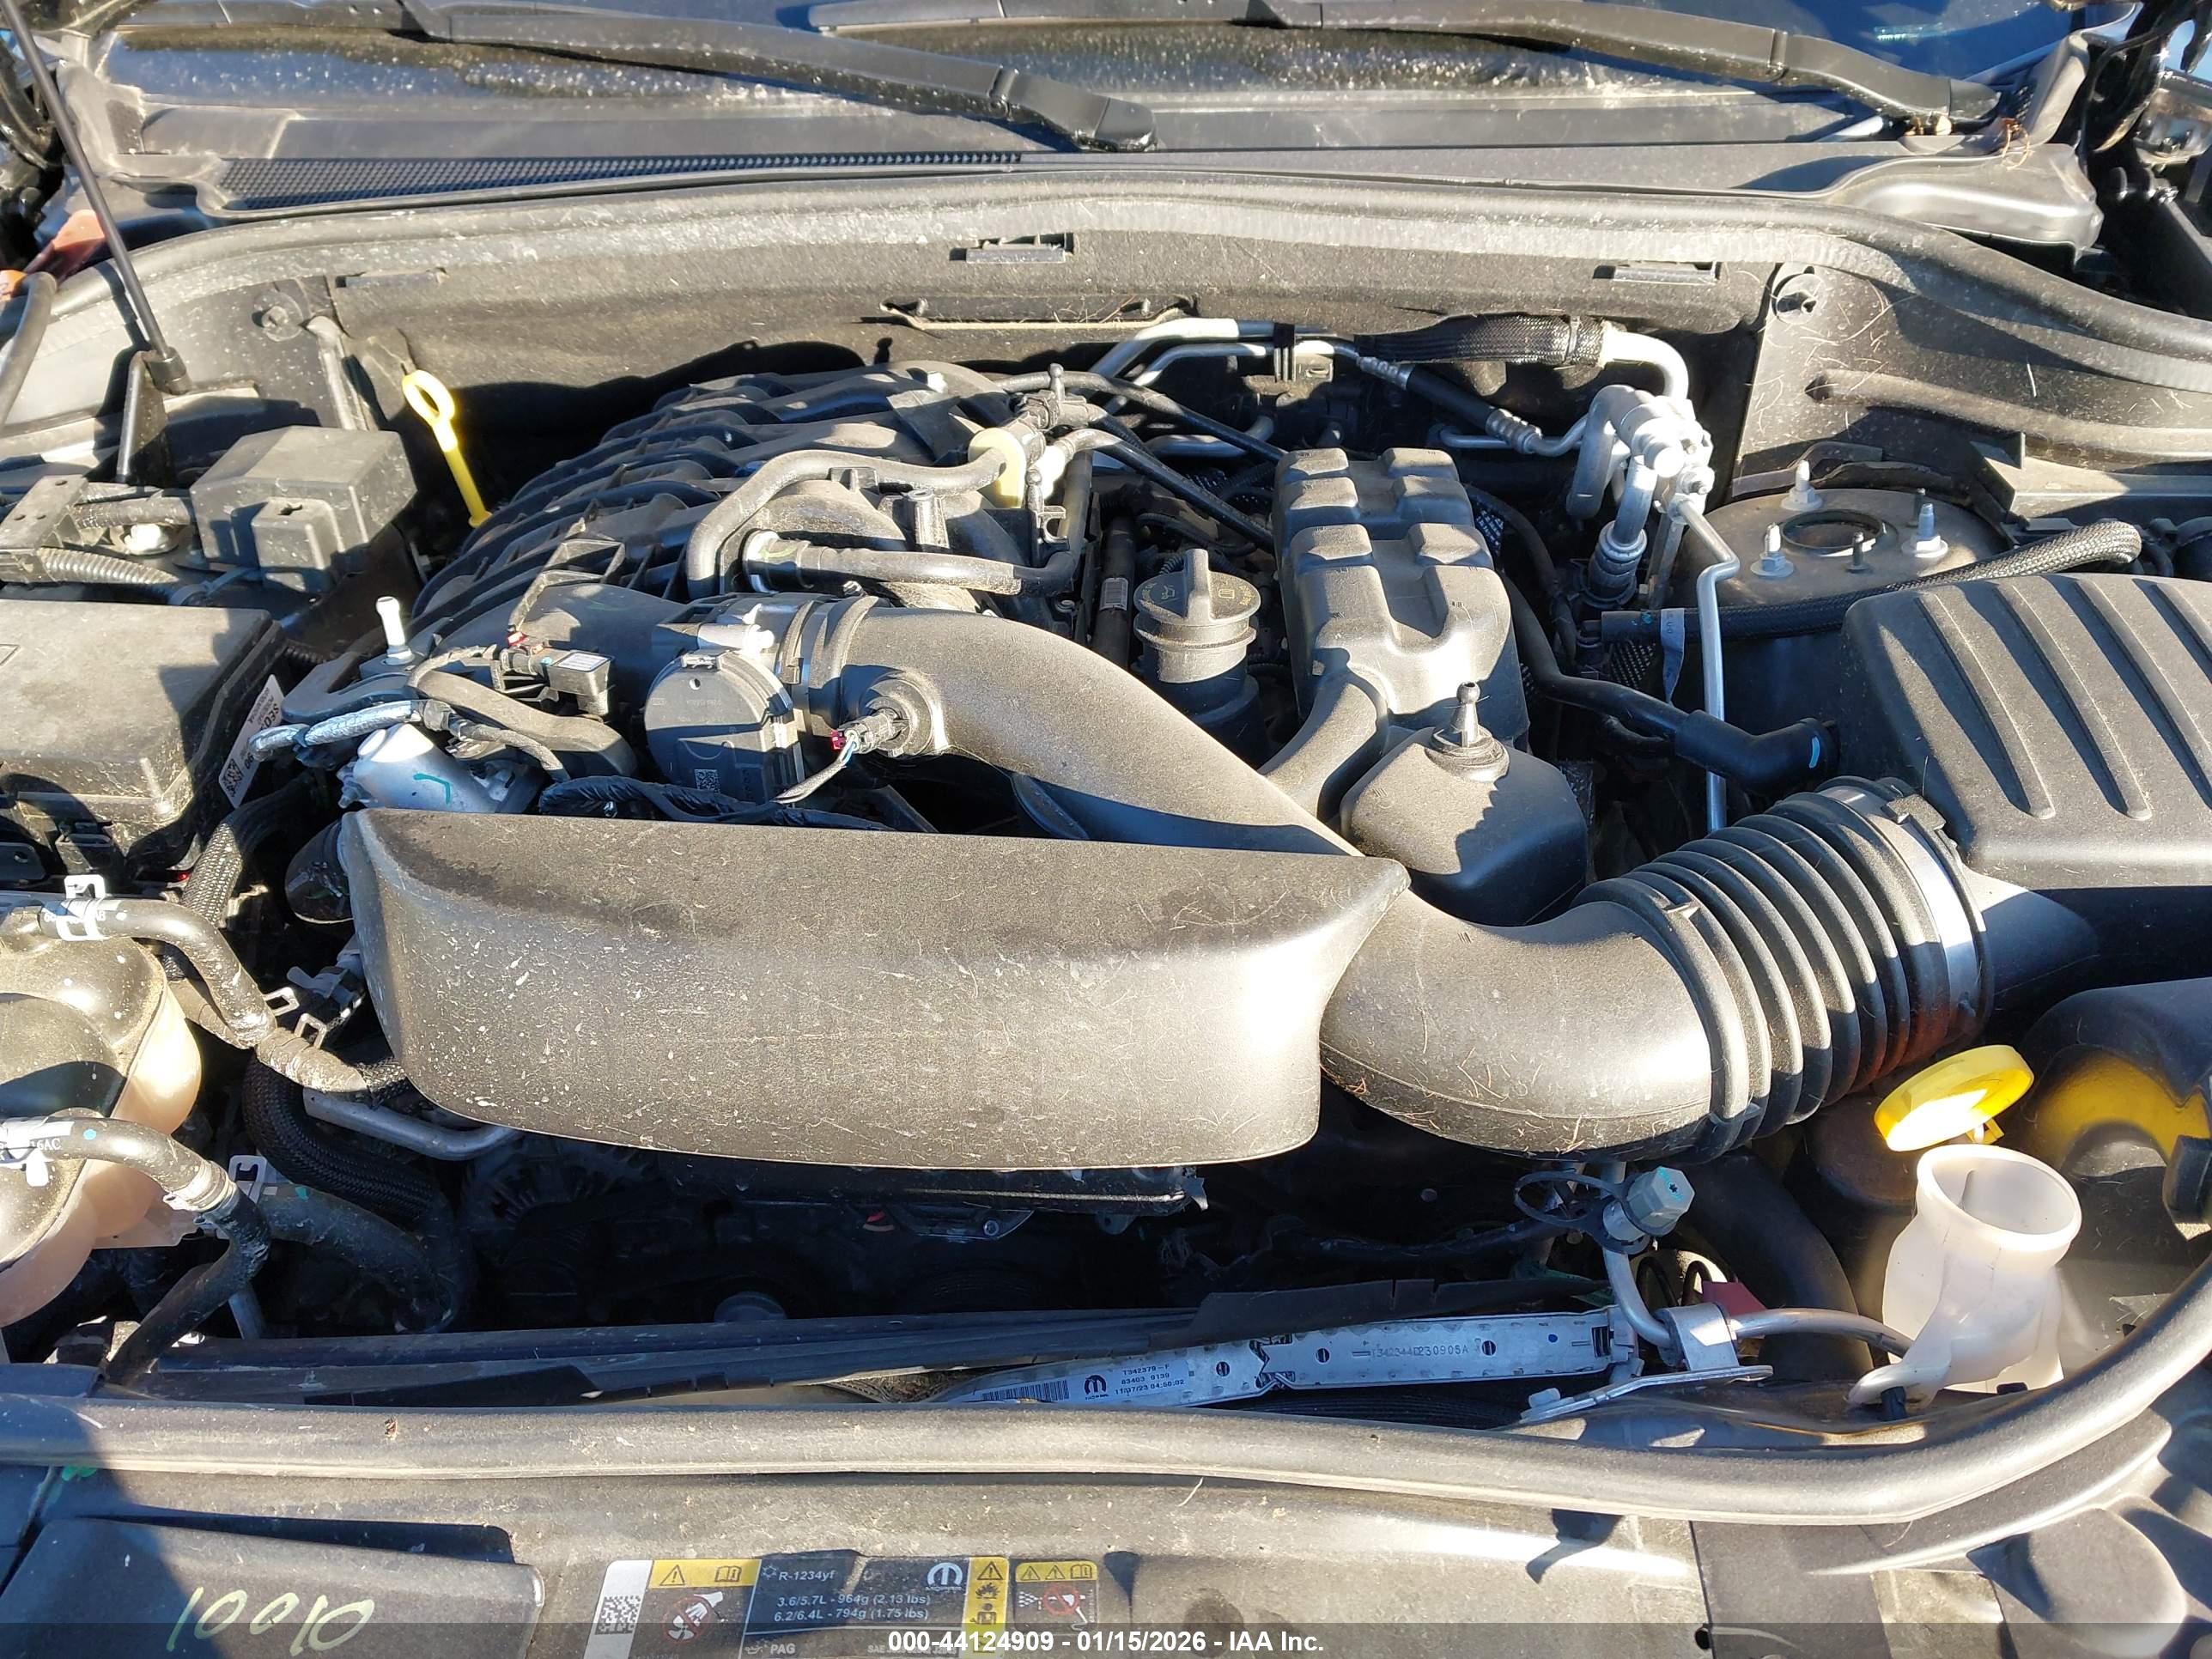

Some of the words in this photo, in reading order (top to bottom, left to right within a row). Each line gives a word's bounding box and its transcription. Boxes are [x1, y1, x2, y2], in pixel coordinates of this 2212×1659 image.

[778, 1570, 837, 1582] R-1234yf
[776, 1595, 827, 1607] 3.6/5.7L
[837, 1594, 869, 1606] 964g
[872, 1593, 904, 1605] (2.13
[906, 1594, 931, 1606] lbs)
[166, 1586, 374, 1656] 10010
[774, 1609, 823, 1622] 6.2/6.4L
[836, 1607, 866, 1620] 794g
[870, 1607, 902, 1620] (1.75
[903, 1607, 928, 1620] lbs)
[770, 1643, 796, 1655] PAG
